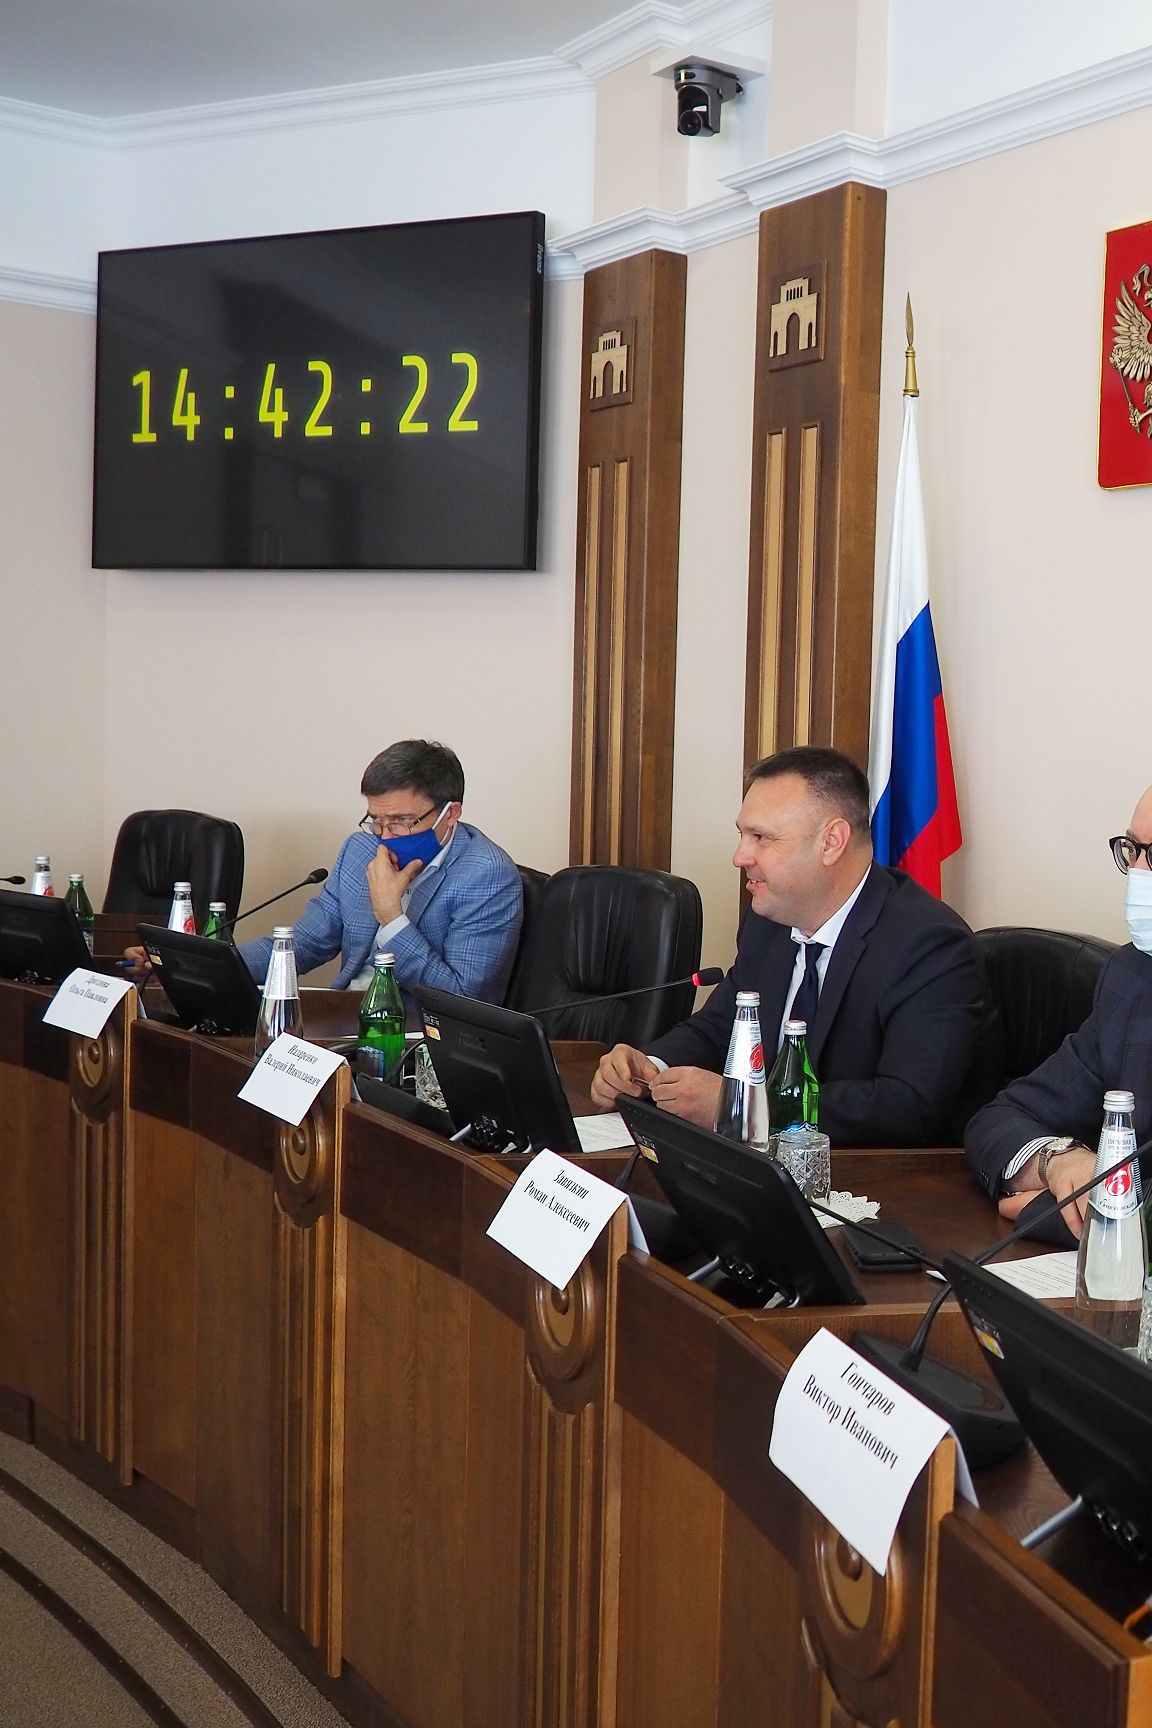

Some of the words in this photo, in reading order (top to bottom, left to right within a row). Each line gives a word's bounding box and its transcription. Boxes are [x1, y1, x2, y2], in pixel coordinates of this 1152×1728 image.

[132, 352, 480, 443] 14:42:22
[264, 1053, 289, 1072] Валерий
[285, 1063, 321, 1087] Николаевич
[287, 1044, 319, 1065] Назаренко
[523, 1180, 548, 1205] Роман
[545, 1195, 591, 1233] Алексеевич
[553, 1169, 590, 1200] Завязкин
[840, 1361, 896, 1416] Гончаров
[803, 1374, 842, 1424] Виктор
[841, 1406, 899, 1470] Иванович
